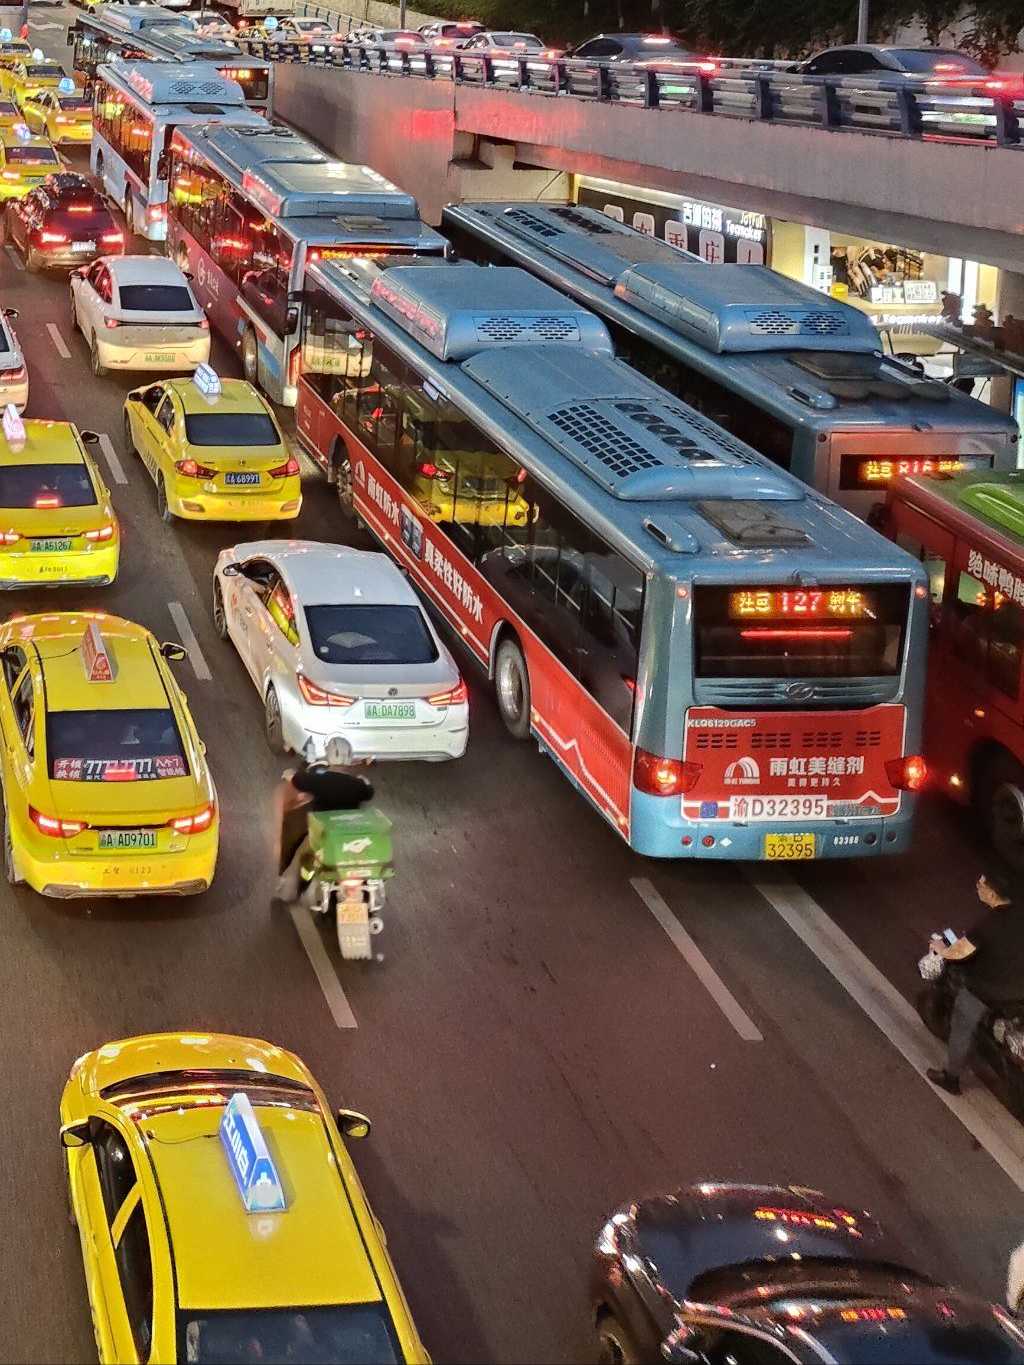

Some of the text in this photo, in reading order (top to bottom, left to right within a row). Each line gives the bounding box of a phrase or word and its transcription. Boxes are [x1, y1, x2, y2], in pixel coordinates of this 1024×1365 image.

[781, 591, 822, 612] 127
[769, 756, 865, 776] 雨虹美缝剂
[733, 797, 825, 818] 渝D32395
[767, 843, 814, 858] 32395
